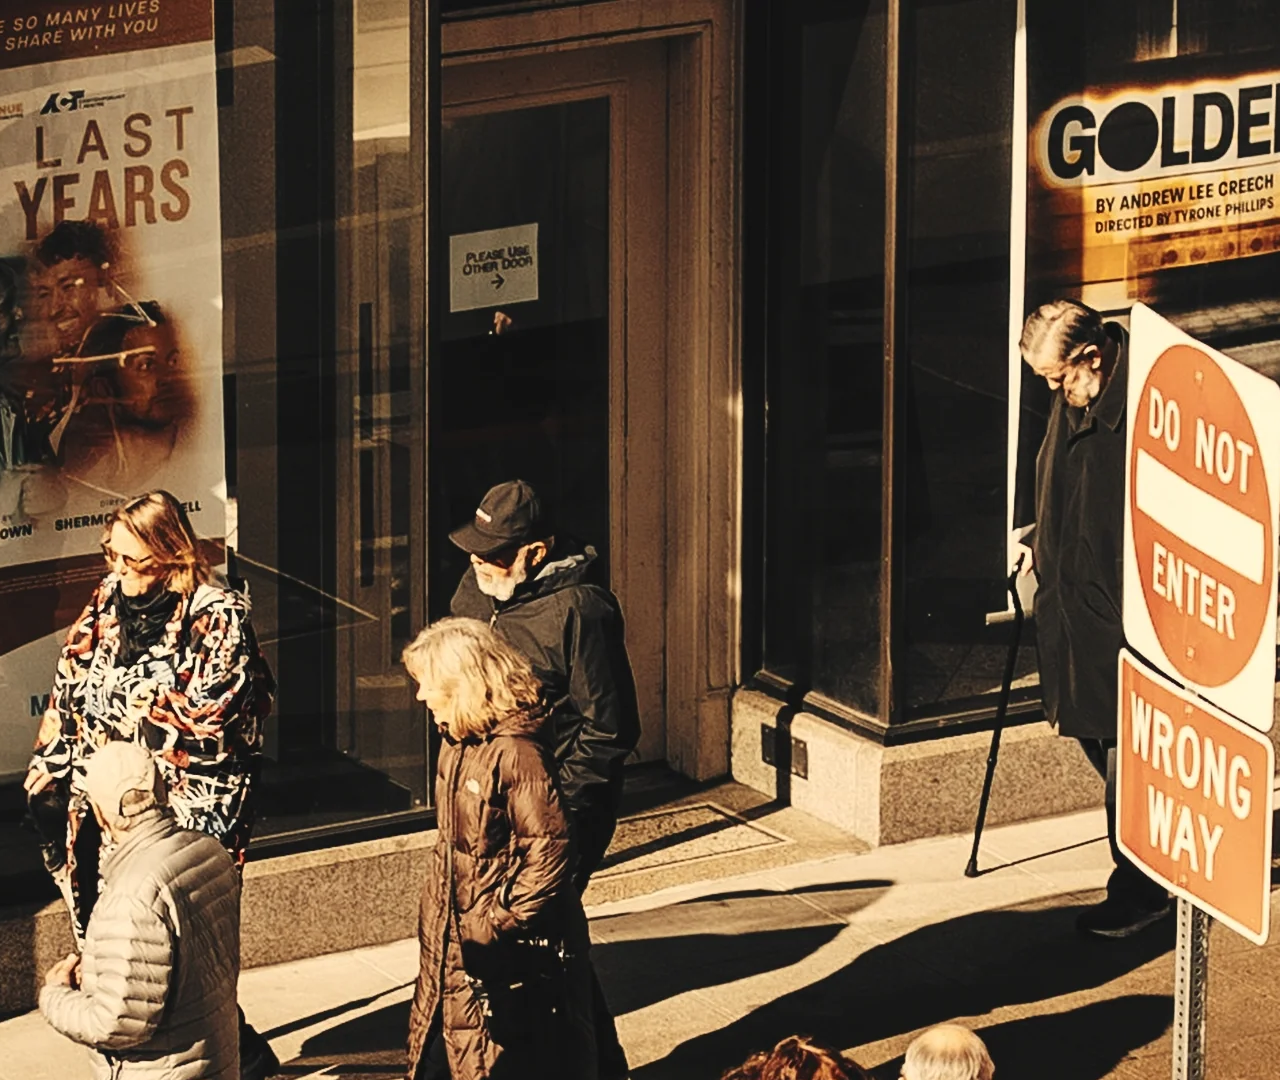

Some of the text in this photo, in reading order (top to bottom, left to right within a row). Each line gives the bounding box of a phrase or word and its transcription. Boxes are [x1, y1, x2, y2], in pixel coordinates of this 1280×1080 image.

[5, 30, 63, 51] SHARE
[70, 24, 115, 41] WITH
[123, 18, 158, 34] YOU
[13, 15, 38, 32] SO
[45, 7, 101, 27] MANY
[108, 0, 160, 18] LIVES
[40, 90, 85, 115] ACT
[35, 106, 194, 169] LAST
[14, 159, 190, 241] YEARS
[1096, 174, 1274, 214] BY ANDREW LEE CREECH
[1095, 197, 1274, 233] DIRECTED BY TYRONE PHILLIPS
[463, 256, 532, 276] OTHER DOOR
[466, 245, 529, 263] PLEASE USE
[1148, 386, 1254, 494] DO NOT
[55, 513, 114, 531] SHERMO
[1153, 541, 1236, 641] ENTER
[1130, 690, 1252, 820] WRONG
[1147, 785, 1224, 881] WAY
